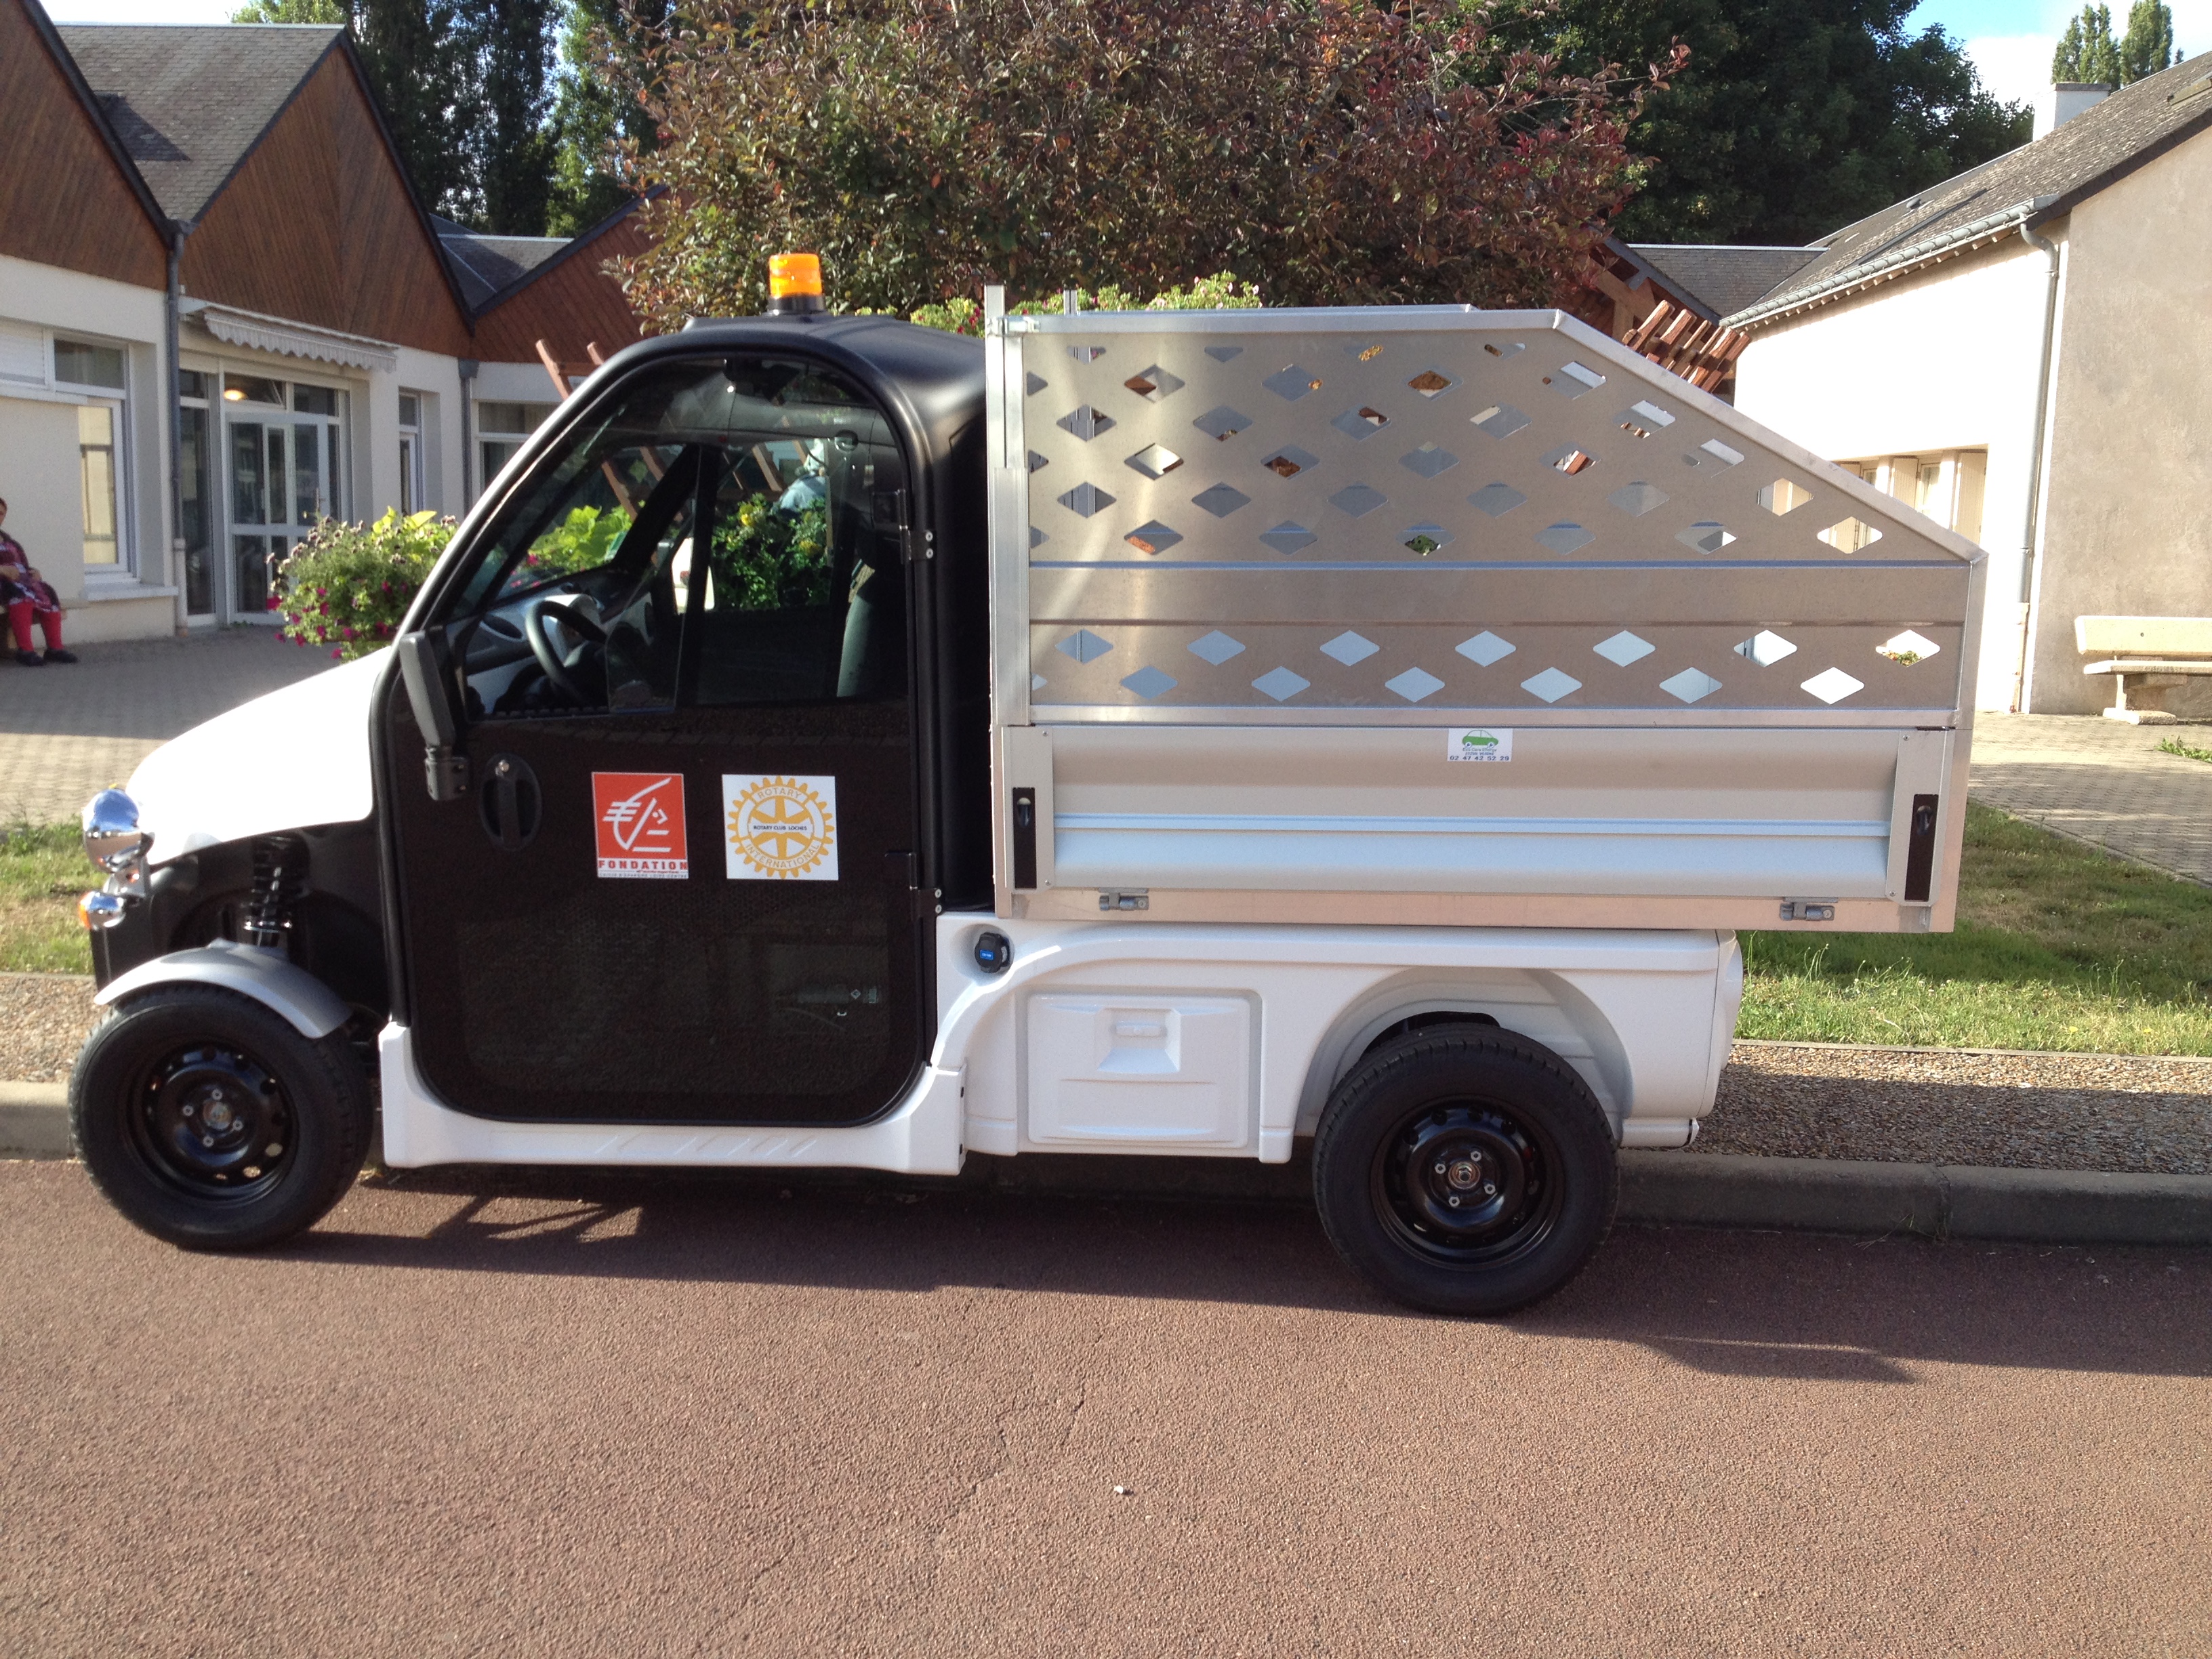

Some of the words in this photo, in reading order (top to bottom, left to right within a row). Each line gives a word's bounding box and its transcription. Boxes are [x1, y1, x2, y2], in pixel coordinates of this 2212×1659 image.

[757, 787, 802, 799] ROTARY
[745, 843, 819, 867] INTERNATIONAL
[598, 860, 687, 870] FONDATION
